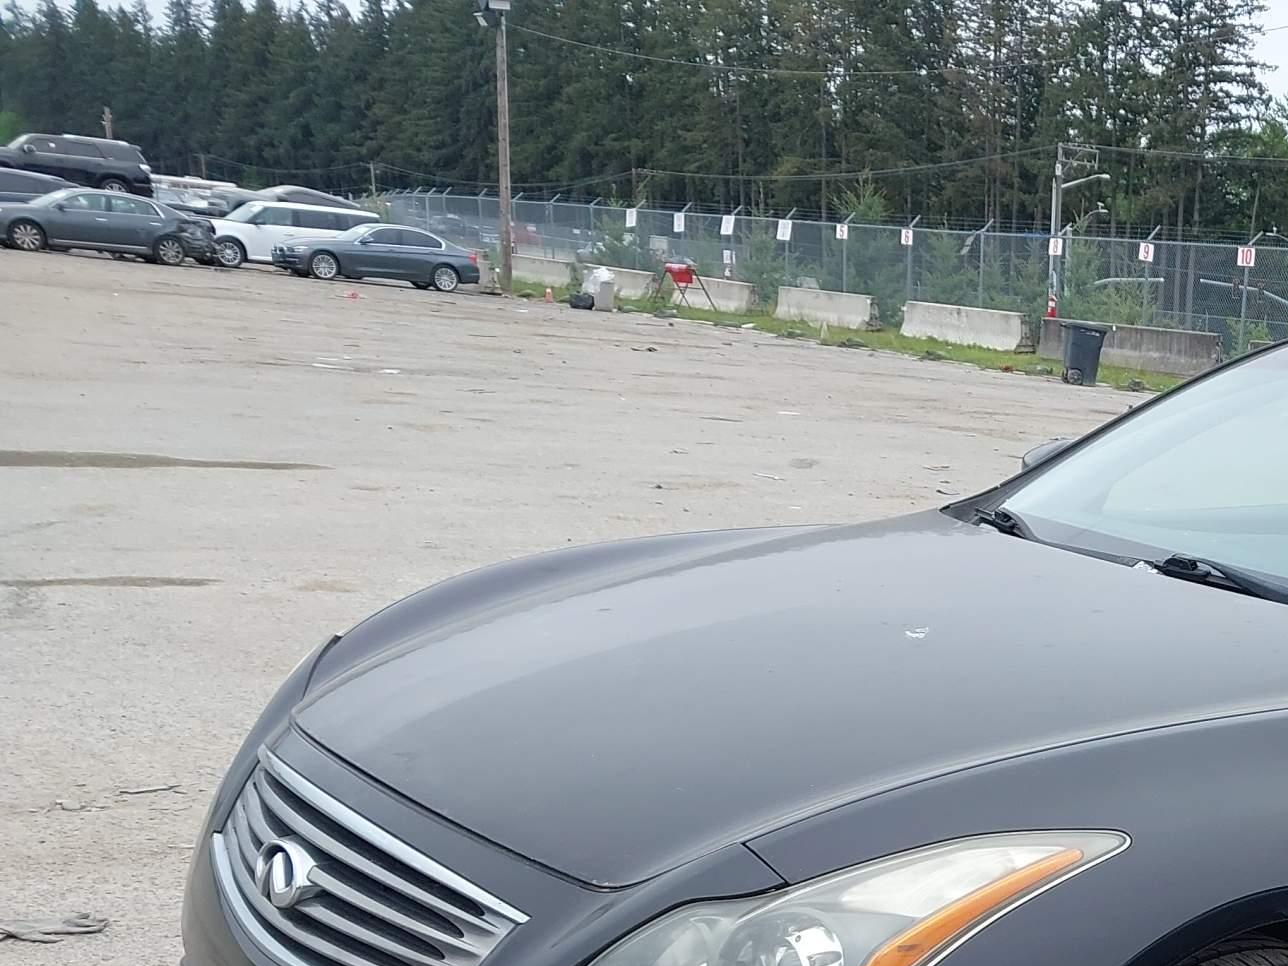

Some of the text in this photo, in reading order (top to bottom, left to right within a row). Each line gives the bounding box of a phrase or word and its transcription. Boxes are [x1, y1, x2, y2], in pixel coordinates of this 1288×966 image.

[839, 225, 846, 237] 5
[1052, 239, 1059, 254] 8
[1143, 244, 1150, 260] 9
[1241, 248, 1252, 265] 10
